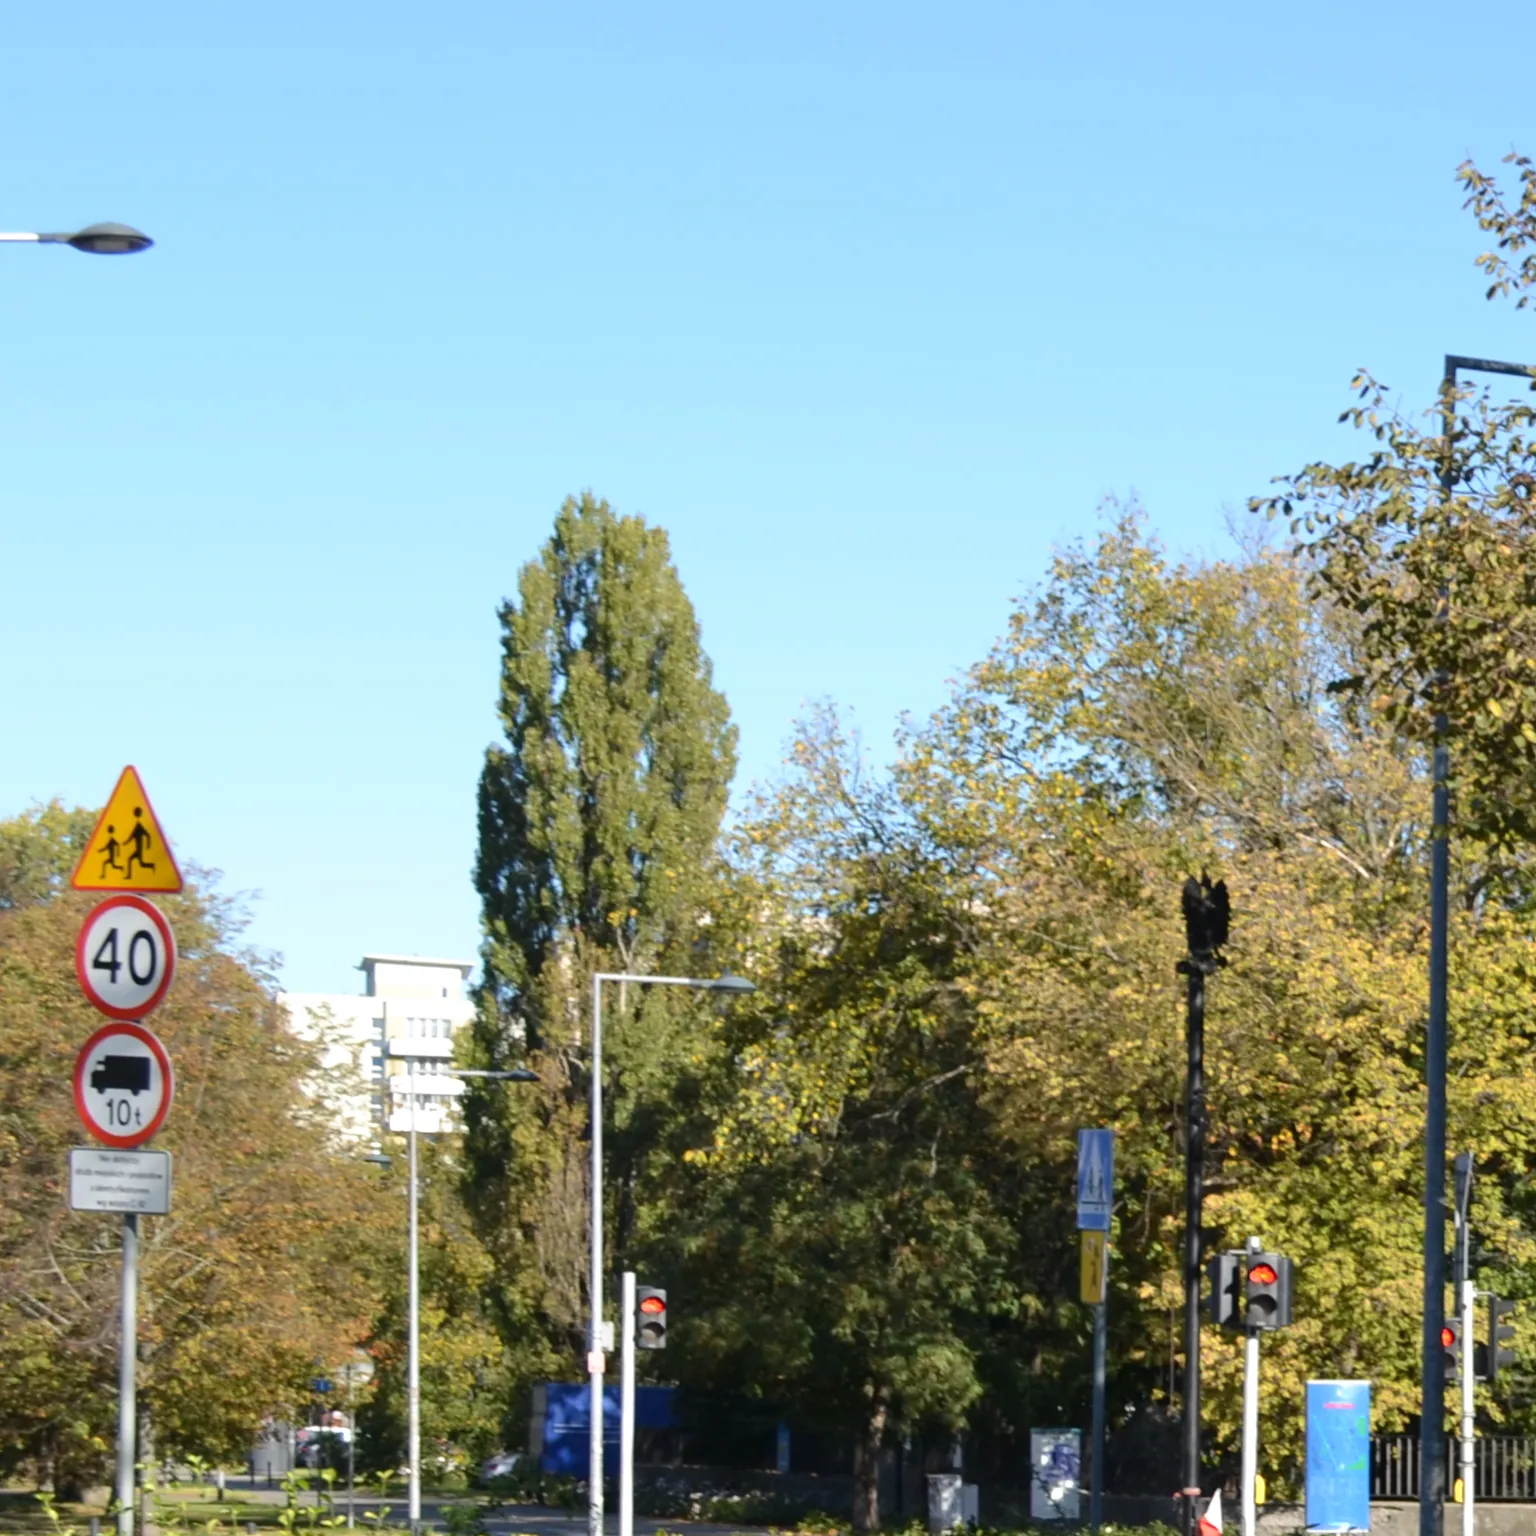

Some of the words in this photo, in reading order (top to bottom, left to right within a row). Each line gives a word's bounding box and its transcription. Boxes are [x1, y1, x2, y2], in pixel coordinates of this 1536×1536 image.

[92, 927, 157, 986] 40
[106, 1098, 131, 1126] 10
[134, 1107, 143, 1126] t
